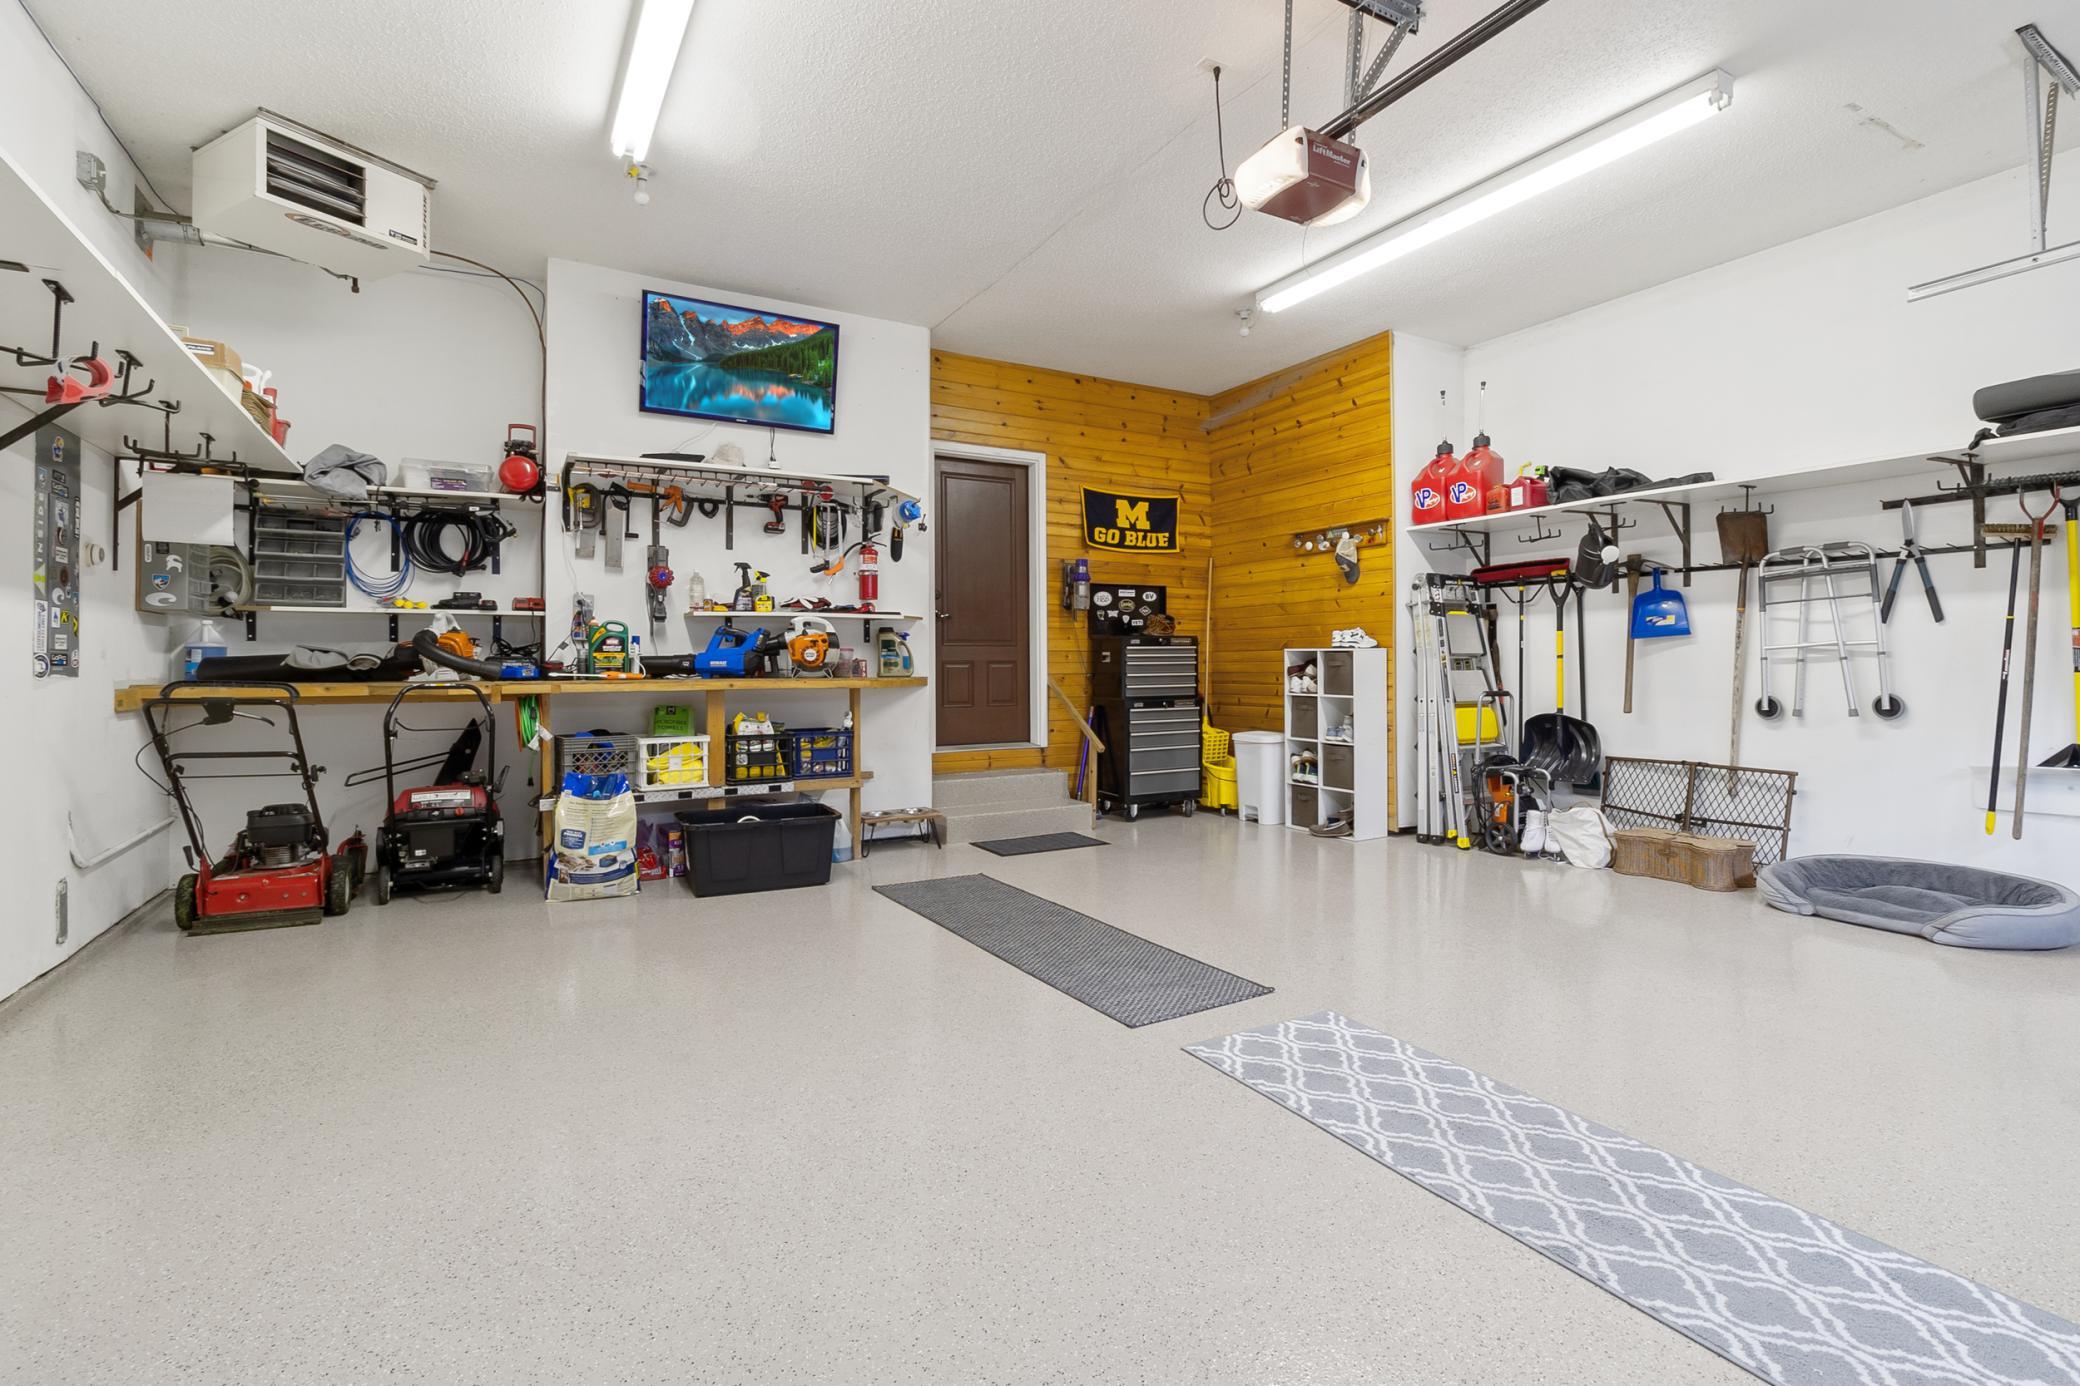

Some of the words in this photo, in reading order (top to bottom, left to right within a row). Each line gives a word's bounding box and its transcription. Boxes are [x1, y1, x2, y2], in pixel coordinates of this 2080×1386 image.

[1312, 143, 1351, 165] LiftMaster
[1415, 488, 1432, 508] VP
[1450, 482, 1468, 503] VP
[1115, 499, 1151, 530] M
[1094, 527, 1120, 545] GO
[1124, 530, 1170, 548] BLUE
